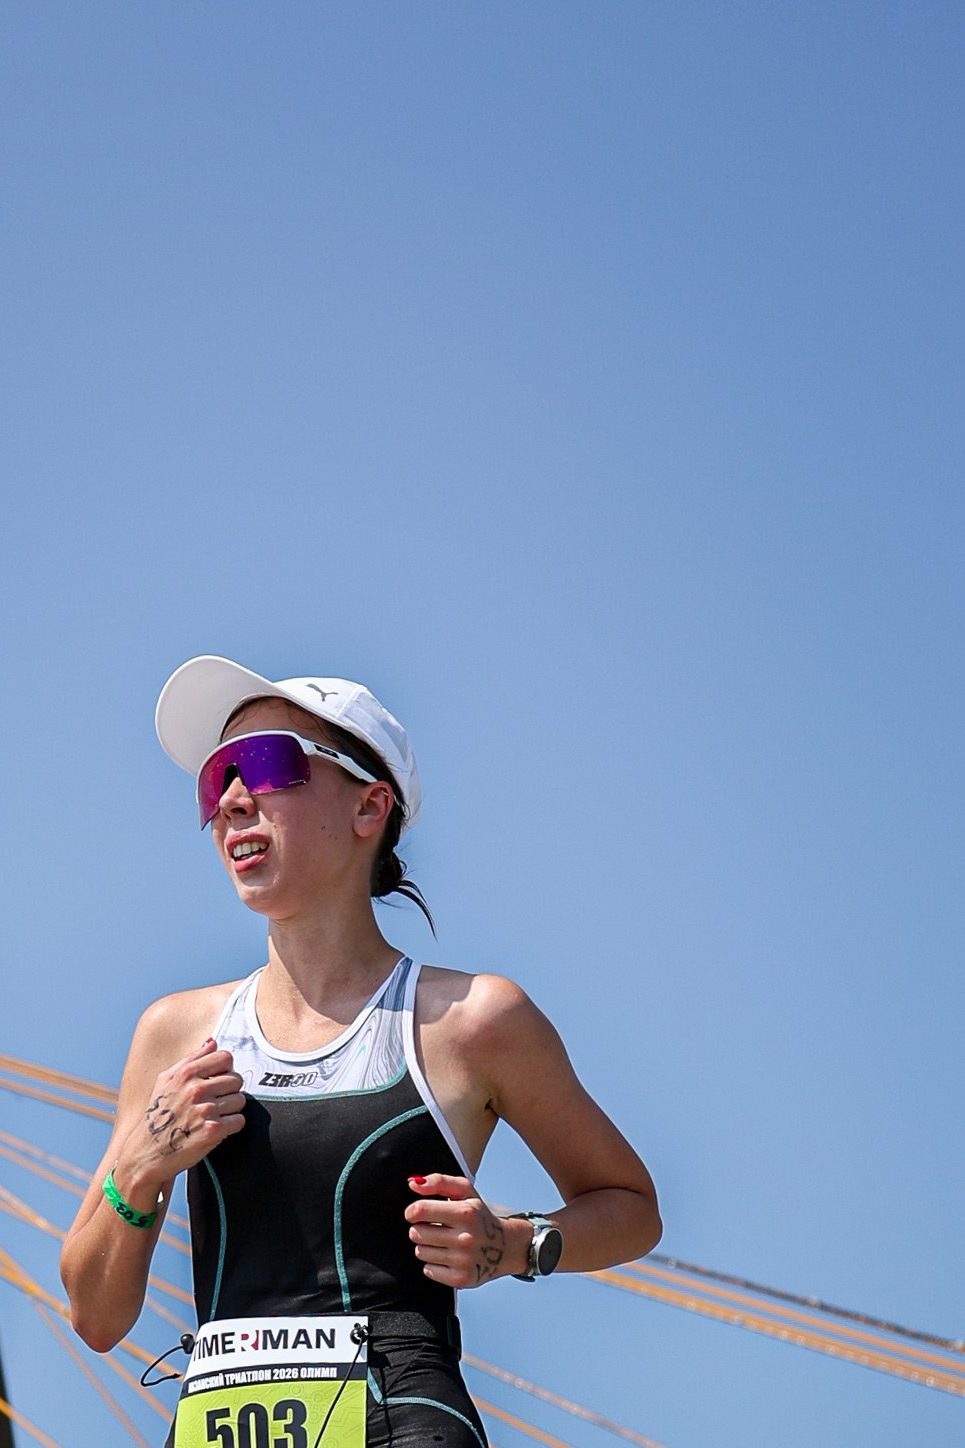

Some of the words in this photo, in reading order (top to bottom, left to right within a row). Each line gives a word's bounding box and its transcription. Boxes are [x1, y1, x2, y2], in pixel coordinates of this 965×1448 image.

[225, 1368, 271, 1386] ТРИАТЛОН
[273, 1368, 299, 1381] 2026
[300, 1366, 337, 1379] ОЛИМП
